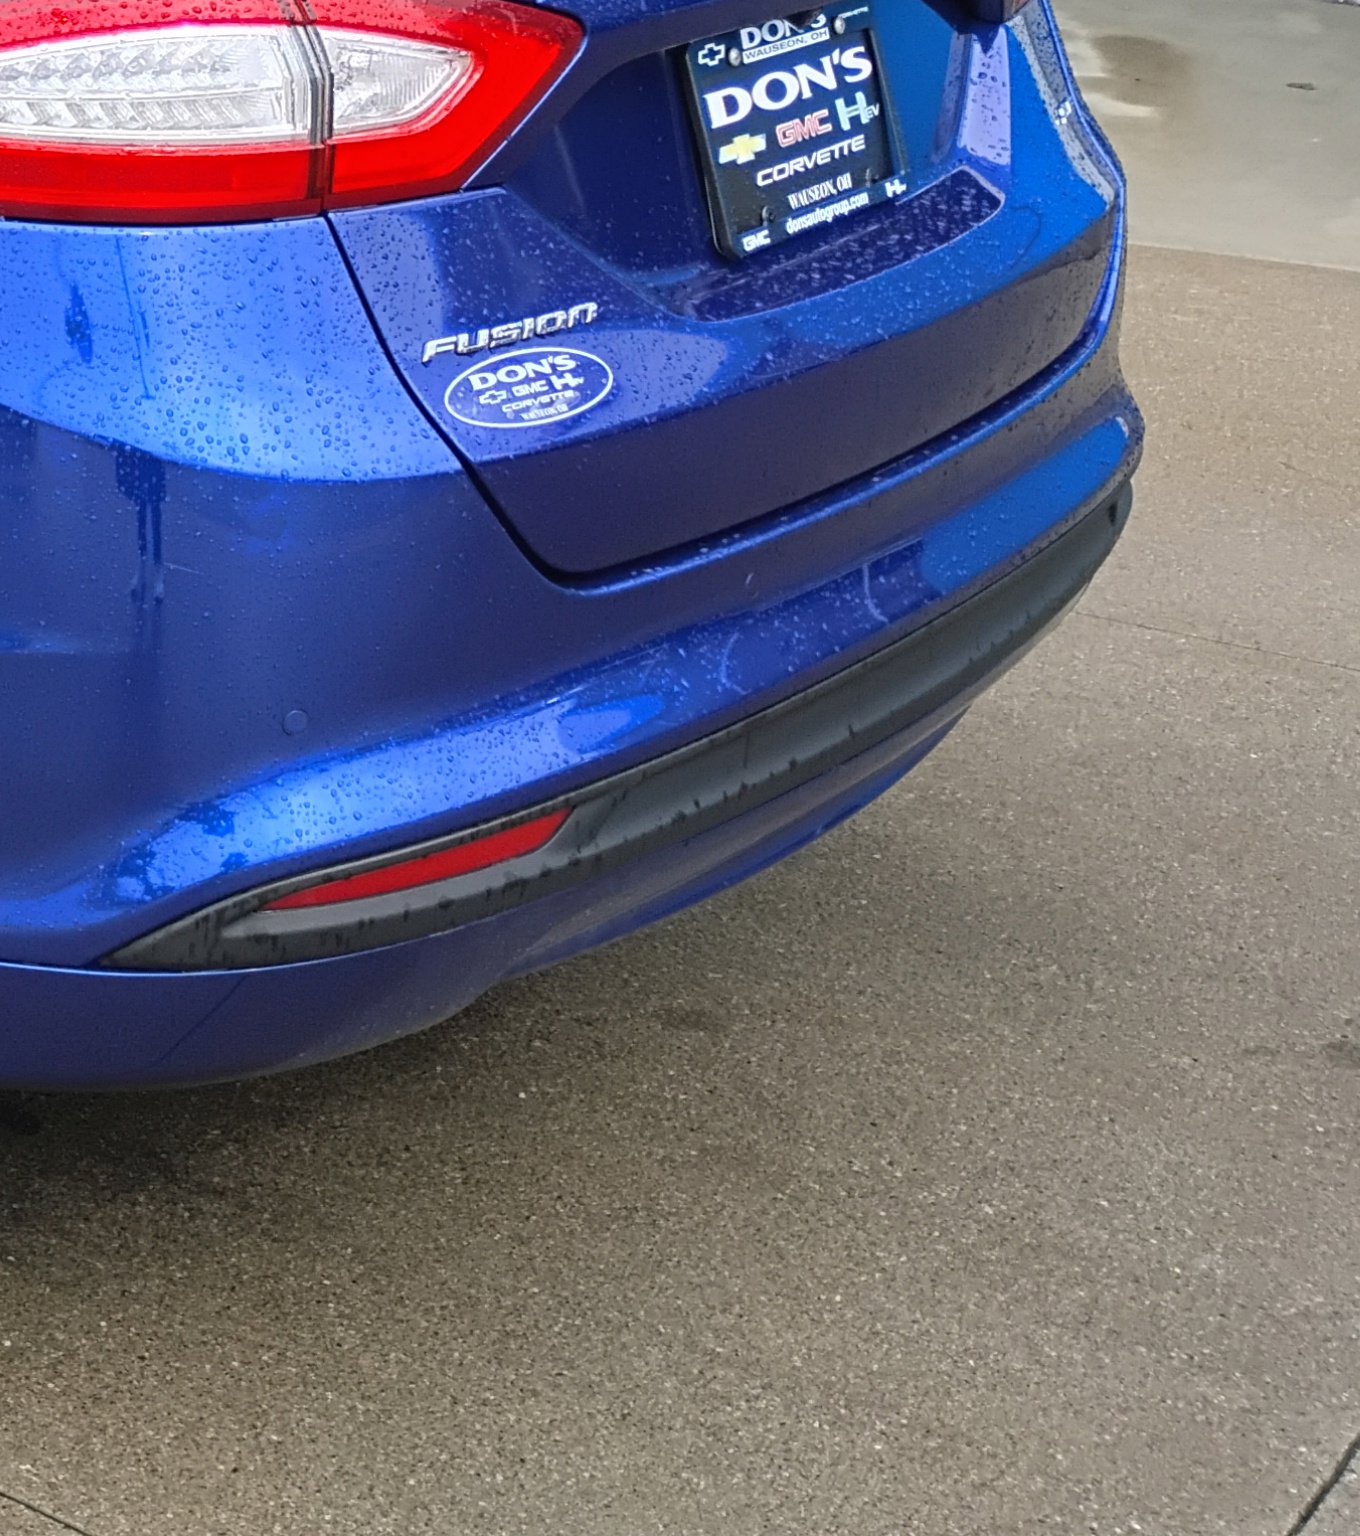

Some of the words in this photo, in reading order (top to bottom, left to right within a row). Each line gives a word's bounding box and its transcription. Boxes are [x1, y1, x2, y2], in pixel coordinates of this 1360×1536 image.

[740, 12, 827, 50] DONS
[811, 29, 828, 41] OH
[702, 45, 873, 129] DON'S
[775, 109, 833, 148] GMC
[756, 133, 867, 187] CORVETTE
[836, 172, 853, 192] OH
[785, 192, 870, 234] donsautogroup.com
[742, 229, 772, 252] GMC
[468, 354, 577, 391] DON'S
[511, 380, 550, 397] GMC
[501, 389, 575, 413] CORVETTE
